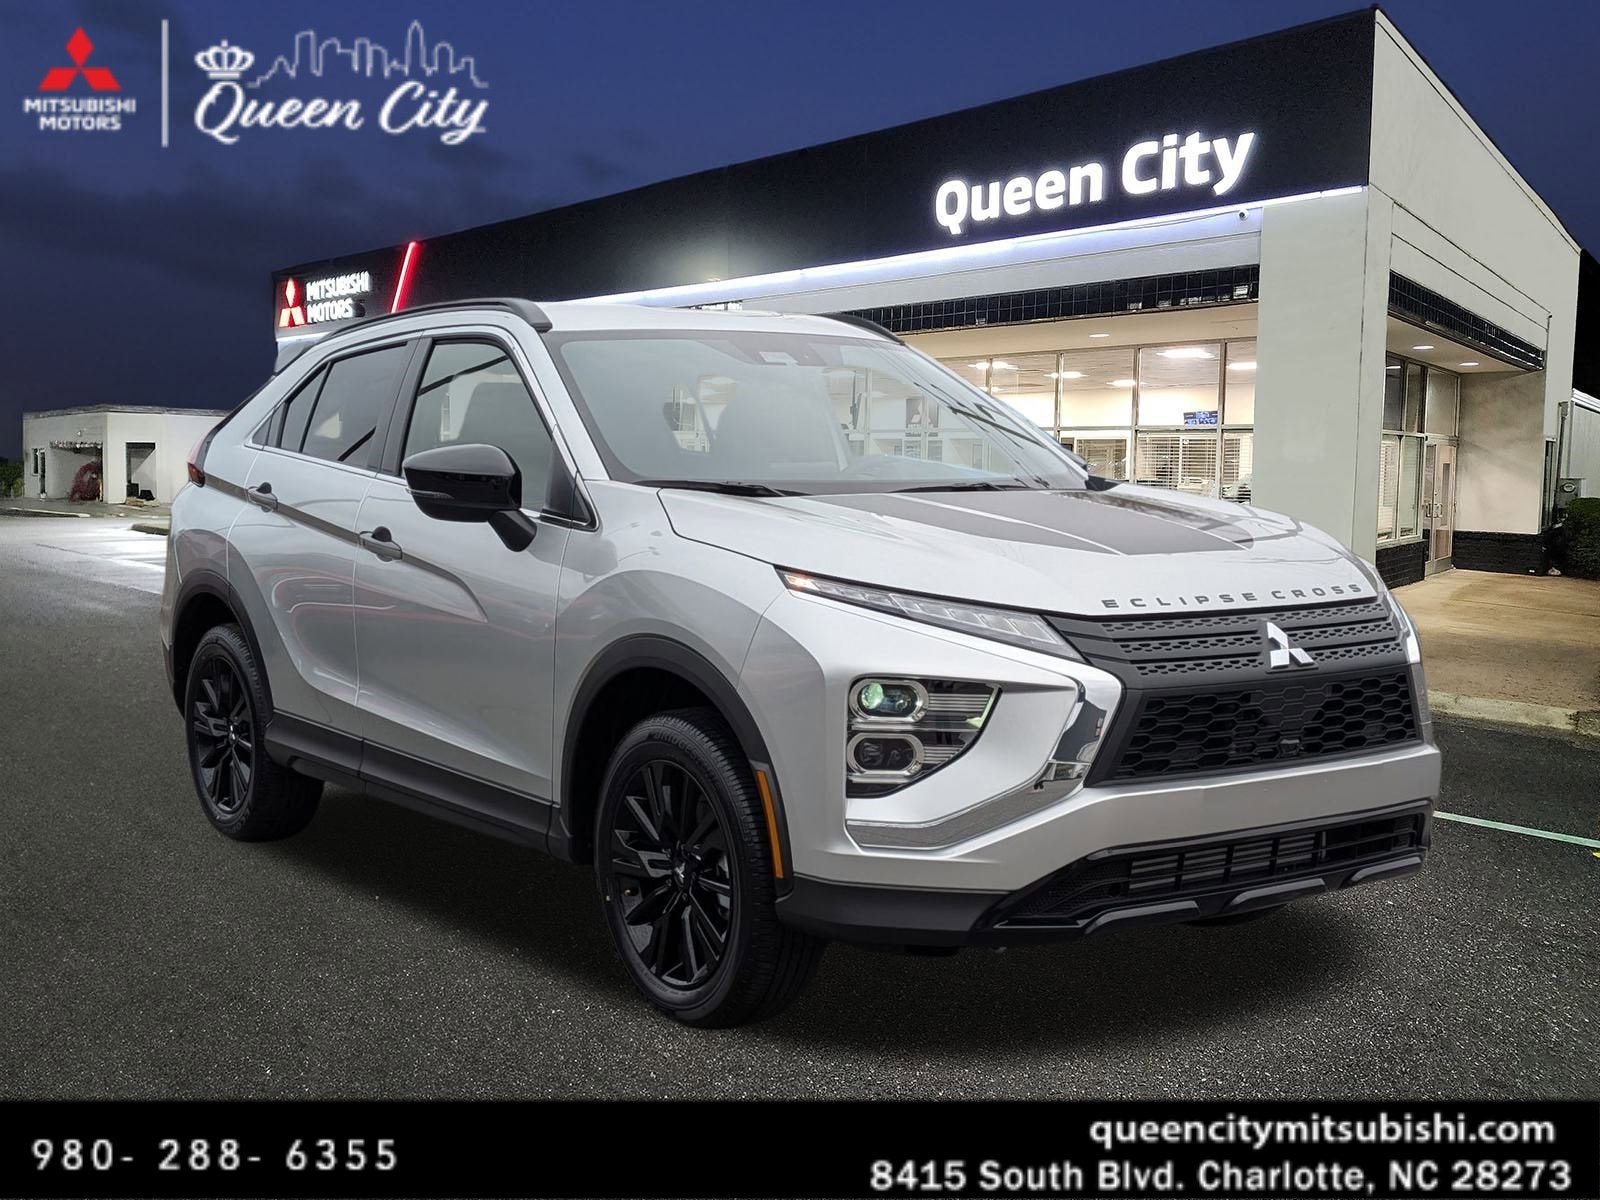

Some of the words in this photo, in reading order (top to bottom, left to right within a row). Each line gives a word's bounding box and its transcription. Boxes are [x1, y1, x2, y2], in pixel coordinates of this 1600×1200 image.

[935, 161, 1104, 235] Queen
[1121, 131, 1256, 196] City
[306, 271, 370, 302] MITSUBISHI
[307, 298, 355, 324] MOTORS
[1101, 591, 1258, 609] ECLIPSE
[1272, 583, 1363, 600] CROSS
